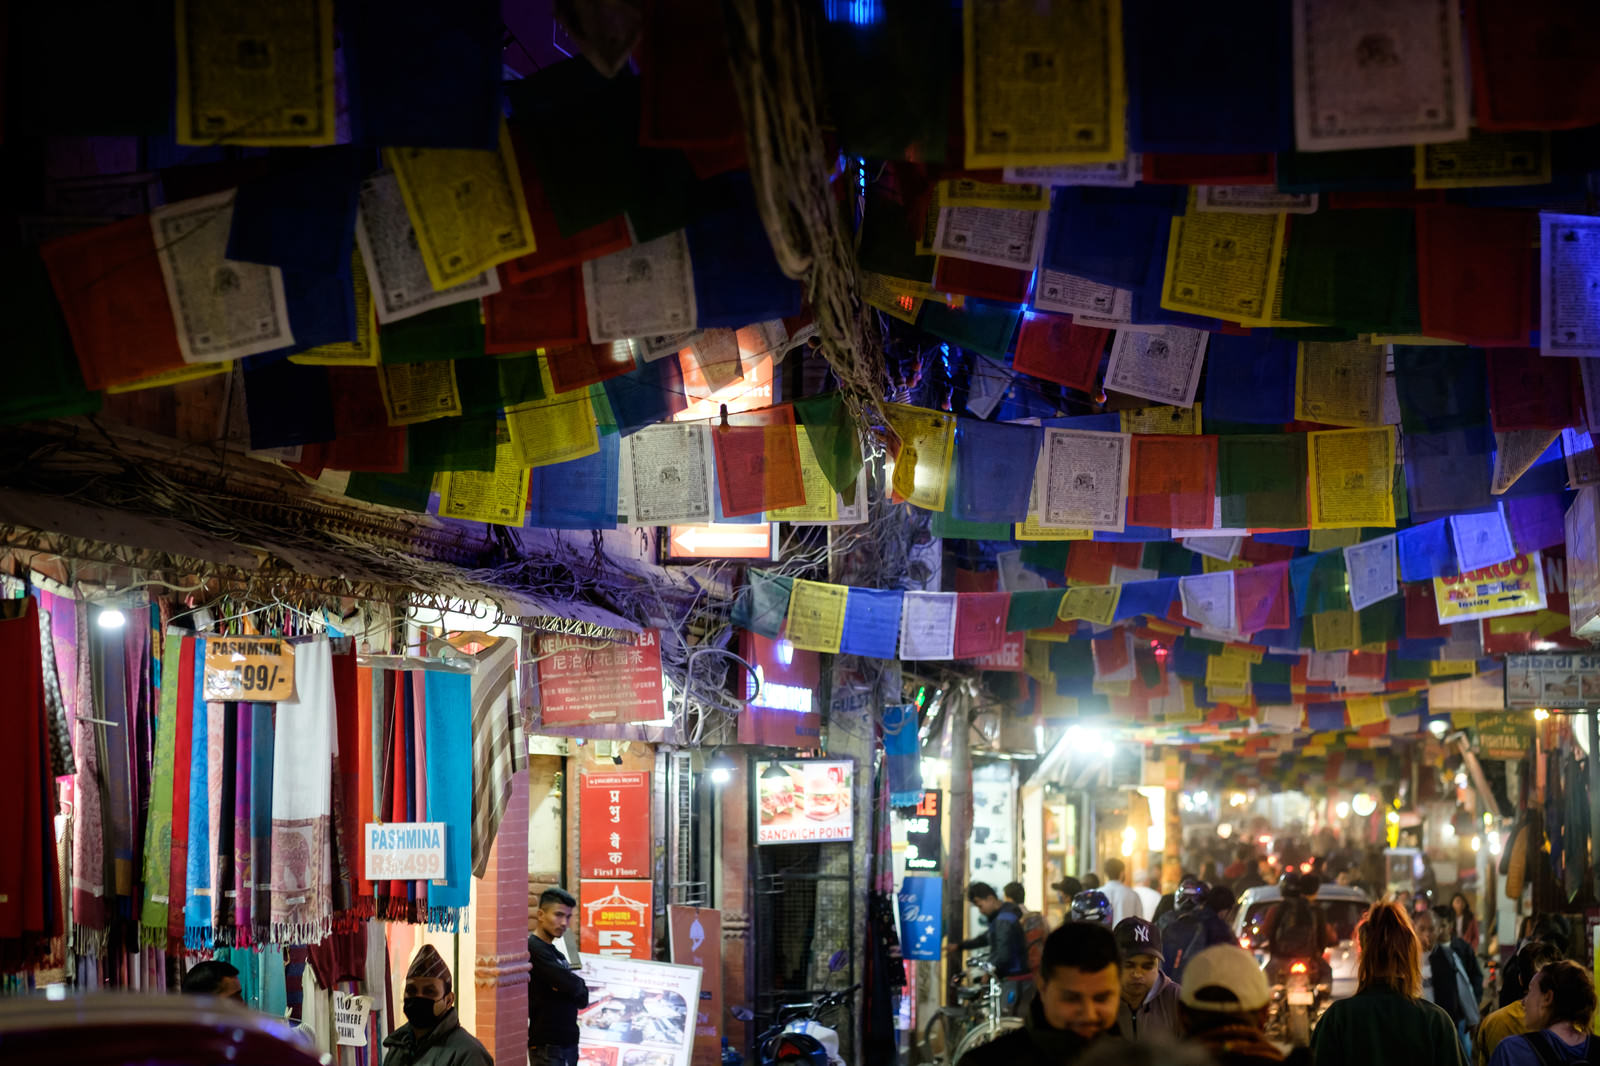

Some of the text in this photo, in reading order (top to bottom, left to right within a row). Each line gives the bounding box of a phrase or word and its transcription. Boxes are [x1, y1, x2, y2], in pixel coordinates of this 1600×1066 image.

[211, 641, 282, 656] PASHMINA
[371, 828, 441, 849] PASHMINA
[760, 826, 850, 841] SANDWICH POINT
[593, 867, 638, 876] First Floor
[1134, 924, 1149, 942] NY
